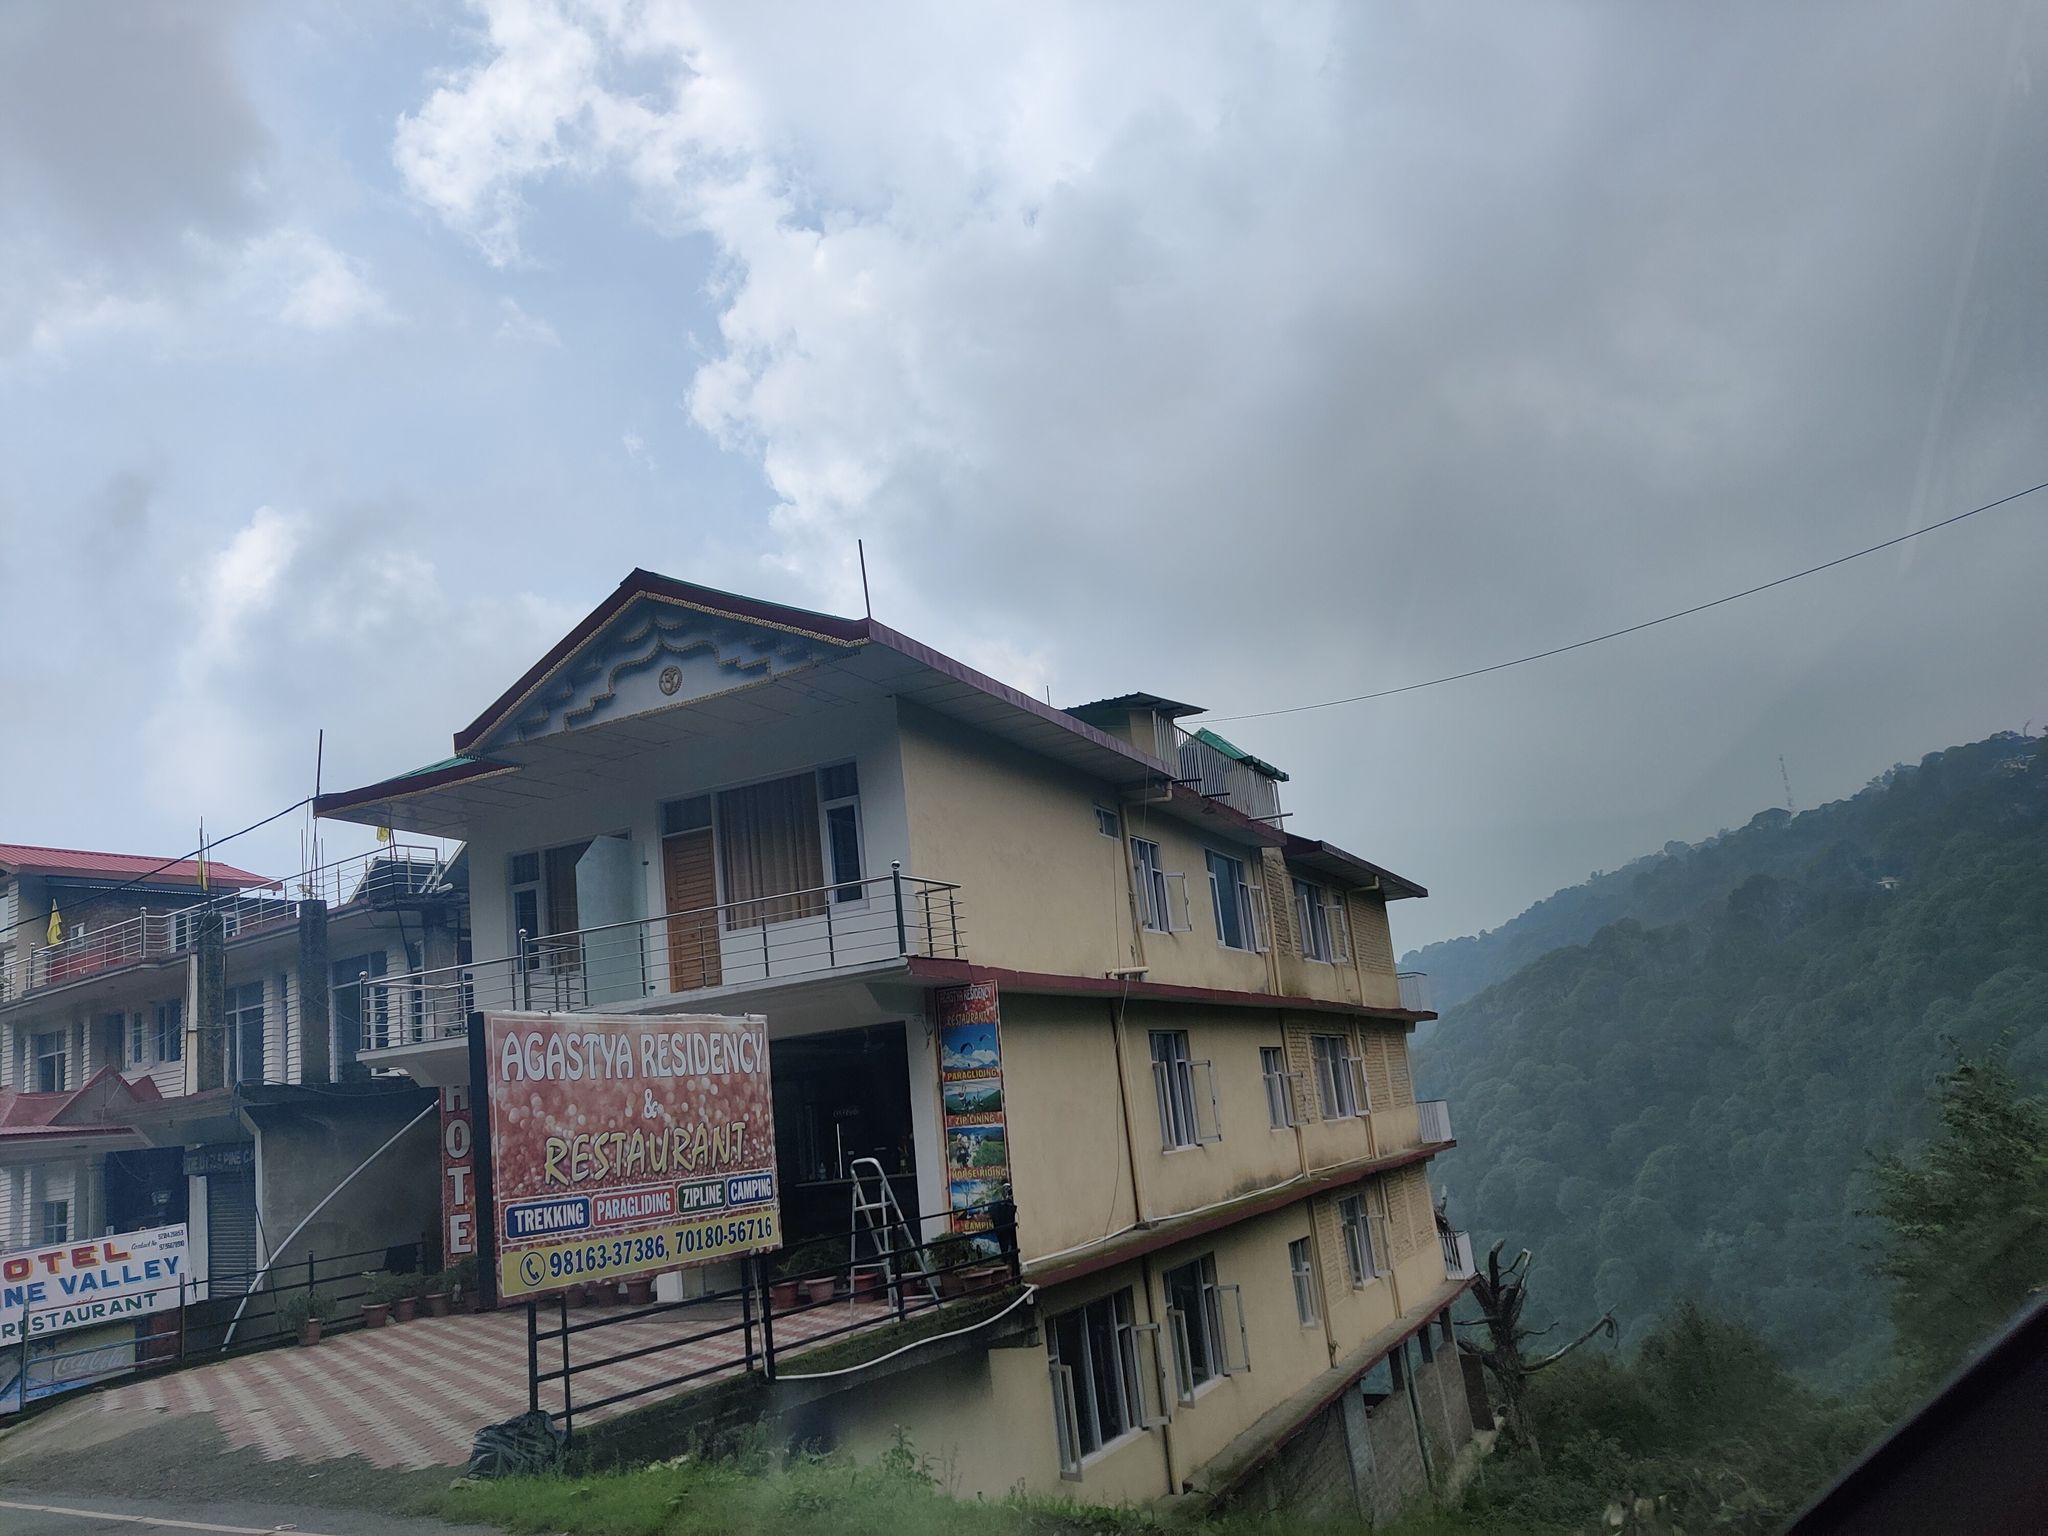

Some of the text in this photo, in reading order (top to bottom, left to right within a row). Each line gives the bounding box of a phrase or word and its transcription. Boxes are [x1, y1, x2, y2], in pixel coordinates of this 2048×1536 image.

[502, 1031, 764, 1081] AGASTYA RESIDENCY
[947, 1068, 997, 1081] PARAGLIDING
[643, 1088, 659, 1120] &
[544, 1121, 746, 1187] RESTAURANT
[683, 1183, 723, 1209] ZIPLINE
[730, 1176, 772, 1202] CAMPING
[514, 1202, 584, 1233] TREKKING
[597, 1192, 671, 1222] PARAGLIDING
[964, 1220, 994, 1231] CAMPIN
[3, 1242, 131, 1283] OTEL
[550, 1216, 772, 1278] 98163-37386, 70180-56716
[0, 1255, 179, 1310] NE VALLEY
[2, 1292, 158, 1339] RESTAURANT
